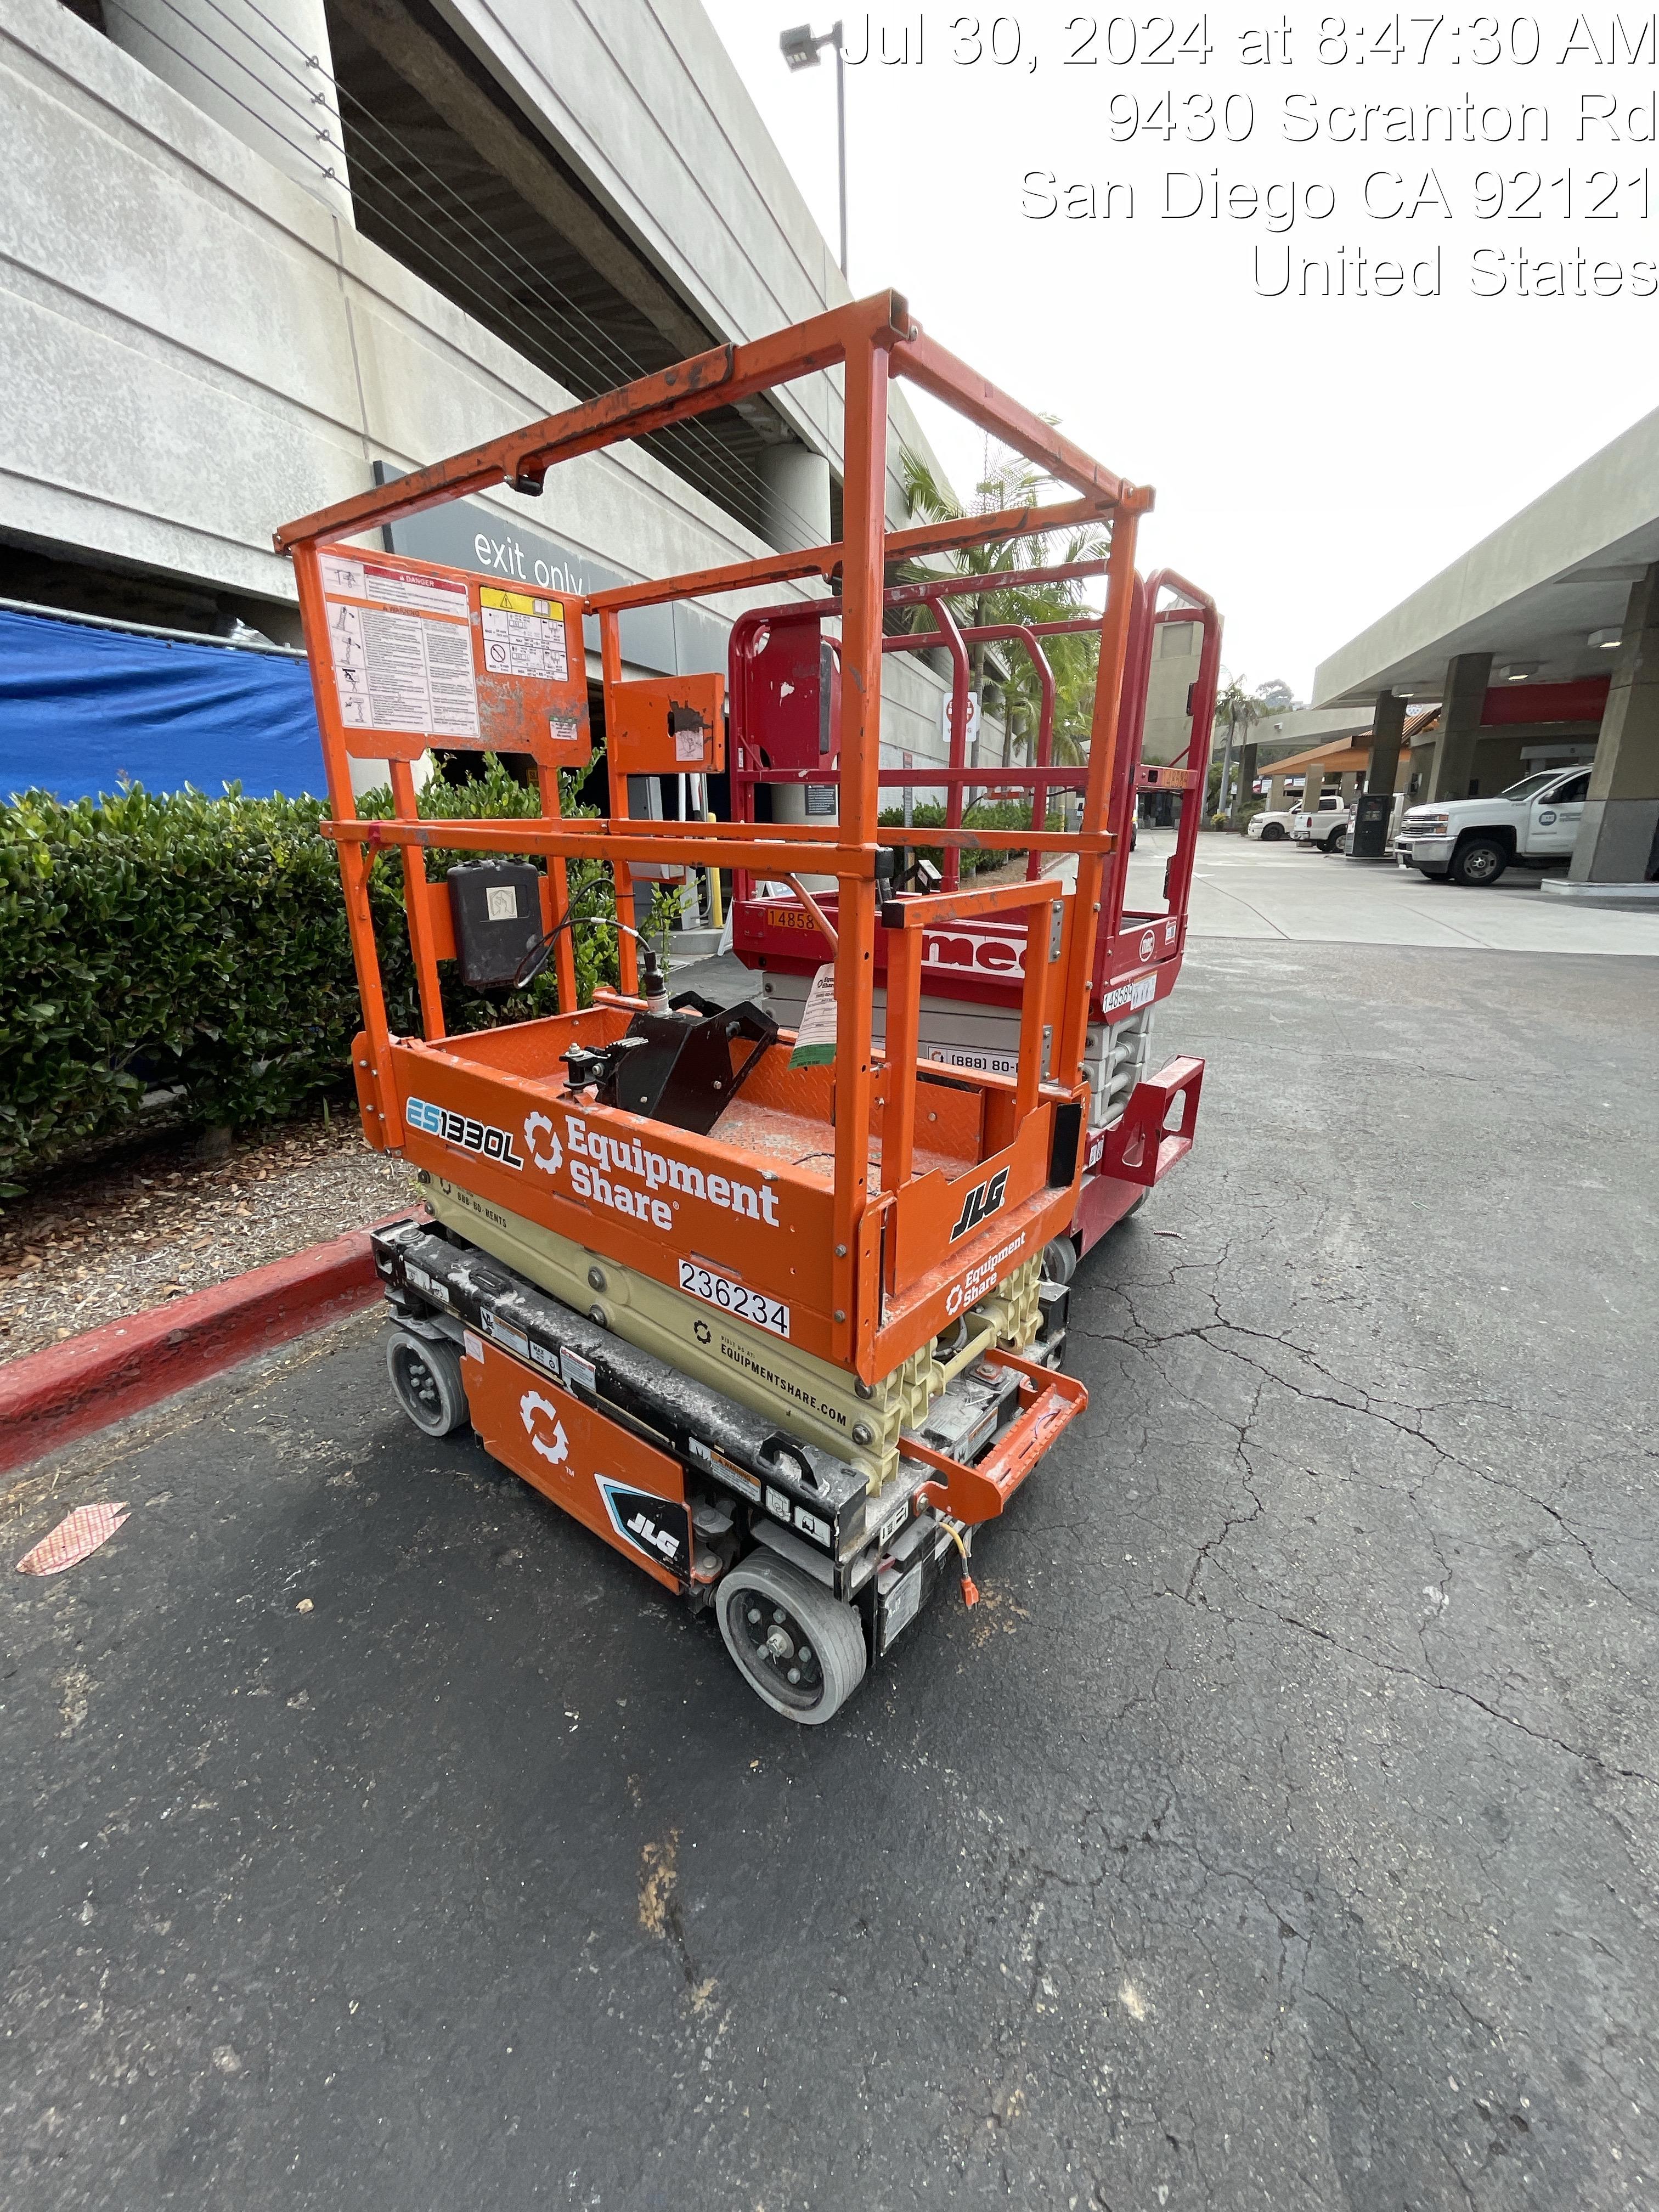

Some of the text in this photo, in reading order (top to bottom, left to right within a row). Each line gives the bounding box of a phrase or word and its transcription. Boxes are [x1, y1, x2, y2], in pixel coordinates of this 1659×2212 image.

[406, 575, 435, 587] DANGER
[475, 533, 583, 595] exit only
[922, 934, 1027, 971] me
[1104, 983, 1133, 1012] 148589
[951, 1054, 987, 1070] (888)
[407, 1097, 523, 1170] ES1330L
[565, 1114, 780, 1228] Equipment
[964, 1231, 1026, 1289] Equipment
[681, 1262, 788, 1334] 236234
[963, 1272, 997, 1308] Share
[721, 1342, 847, 1426] EQUIPMENTSHARE.COM
[627, 1513, 680, 1559] JLG
